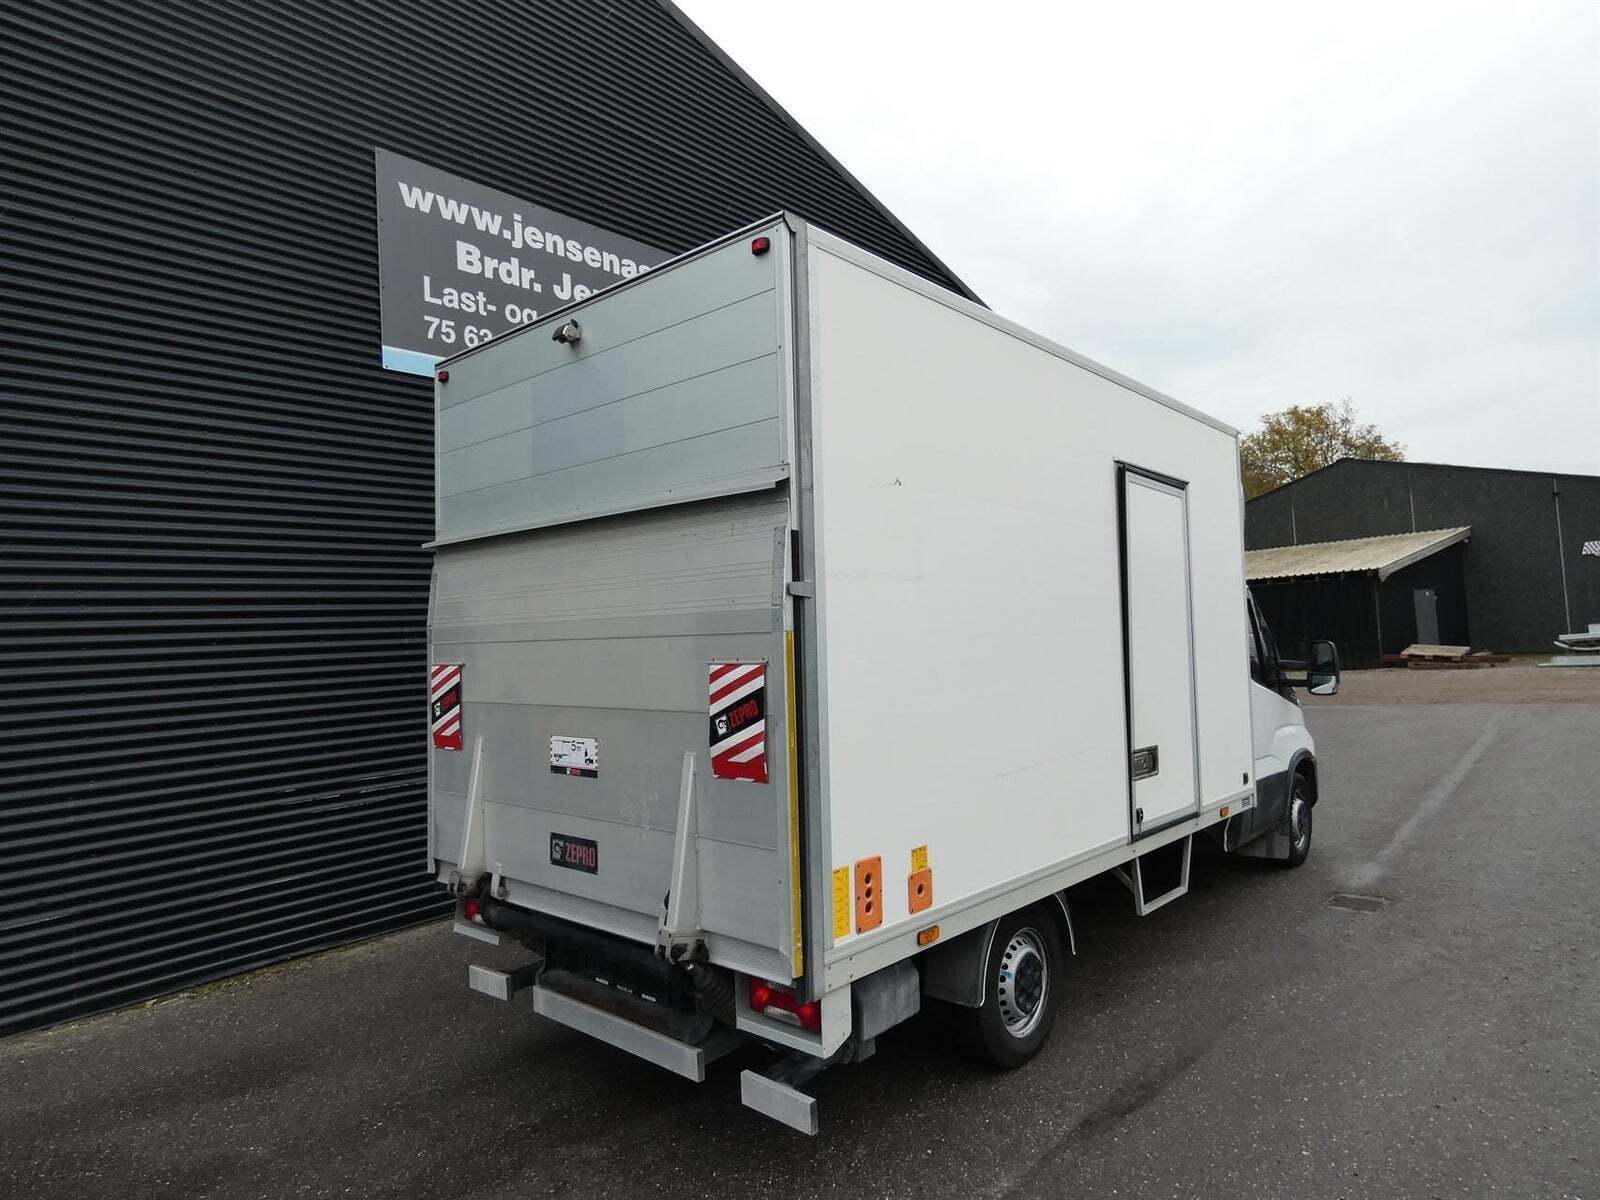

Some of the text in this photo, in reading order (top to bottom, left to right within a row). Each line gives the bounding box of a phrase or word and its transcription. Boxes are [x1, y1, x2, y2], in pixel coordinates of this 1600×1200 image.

[456, 240, 600, 301] Brdr. Je
[423, 276, 496, 316] Last-
[423, 315, 456, 344] 75
[729, 700, 759, 728] ZEPRO
[565, 842, 597, 868] ZEPRO
